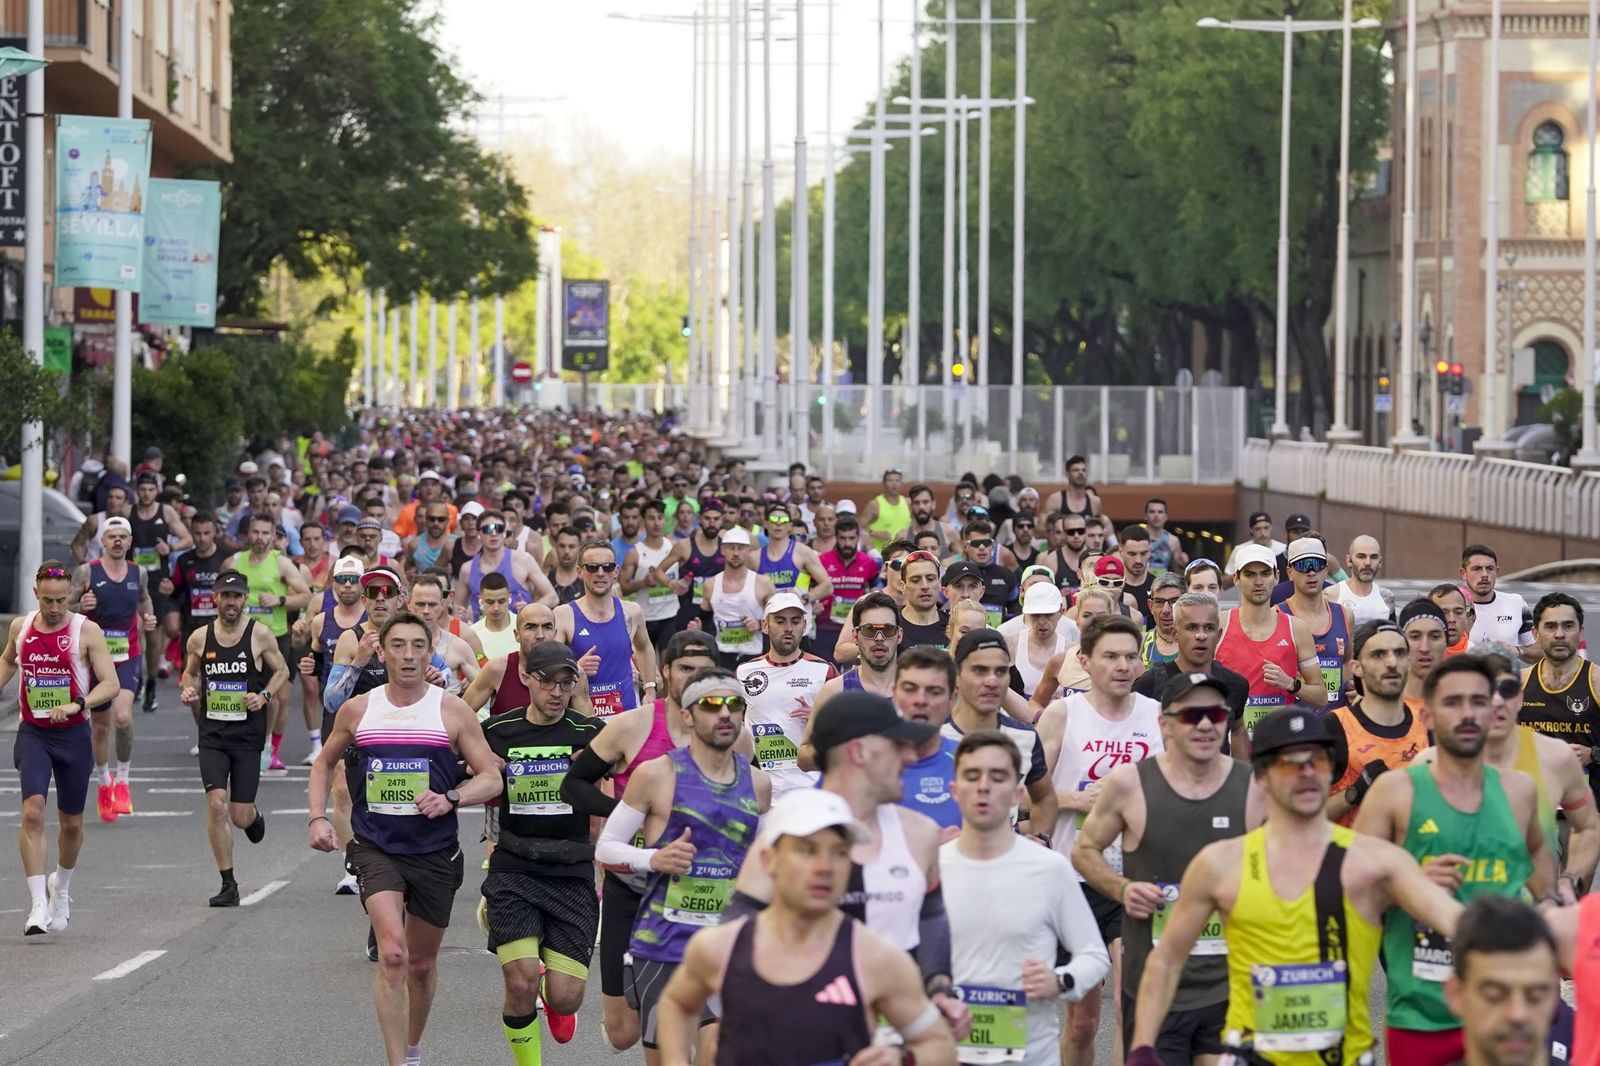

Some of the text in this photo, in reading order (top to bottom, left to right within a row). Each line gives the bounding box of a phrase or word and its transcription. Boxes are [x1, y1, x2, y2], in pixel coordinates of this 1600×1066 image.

[60, 217, 140, 237] SEVILLA
[205, 661, 247, 675] CARLOS
[592, 684, 616, 693] ZURICH
[34, 699, 61, 709] JUSTO
[211, 702, 241, 711] CARLOS
[1082, 740, 1133, 753] ATHLE
[760, 748, 798, 760] GERMAN
[386, 762, 422, 770] ZURICH
[528, 763, 562, 773] ZURICH
[387, 779, 406, 787] 2478
[529, 780, 549, 788] 2446
[380, 789, 415, 802] KRISS
[696, 865, 732, 876] ZURICH
[680, 895, 724, 911] SERGY
[1280, 968, 1334, 983] ZURICH
[968, 989, 1017, 1003] ZURICH
[1271, 1010, 1329, 1030] JAMES
[970, 1028, 994, 1045] GIL
